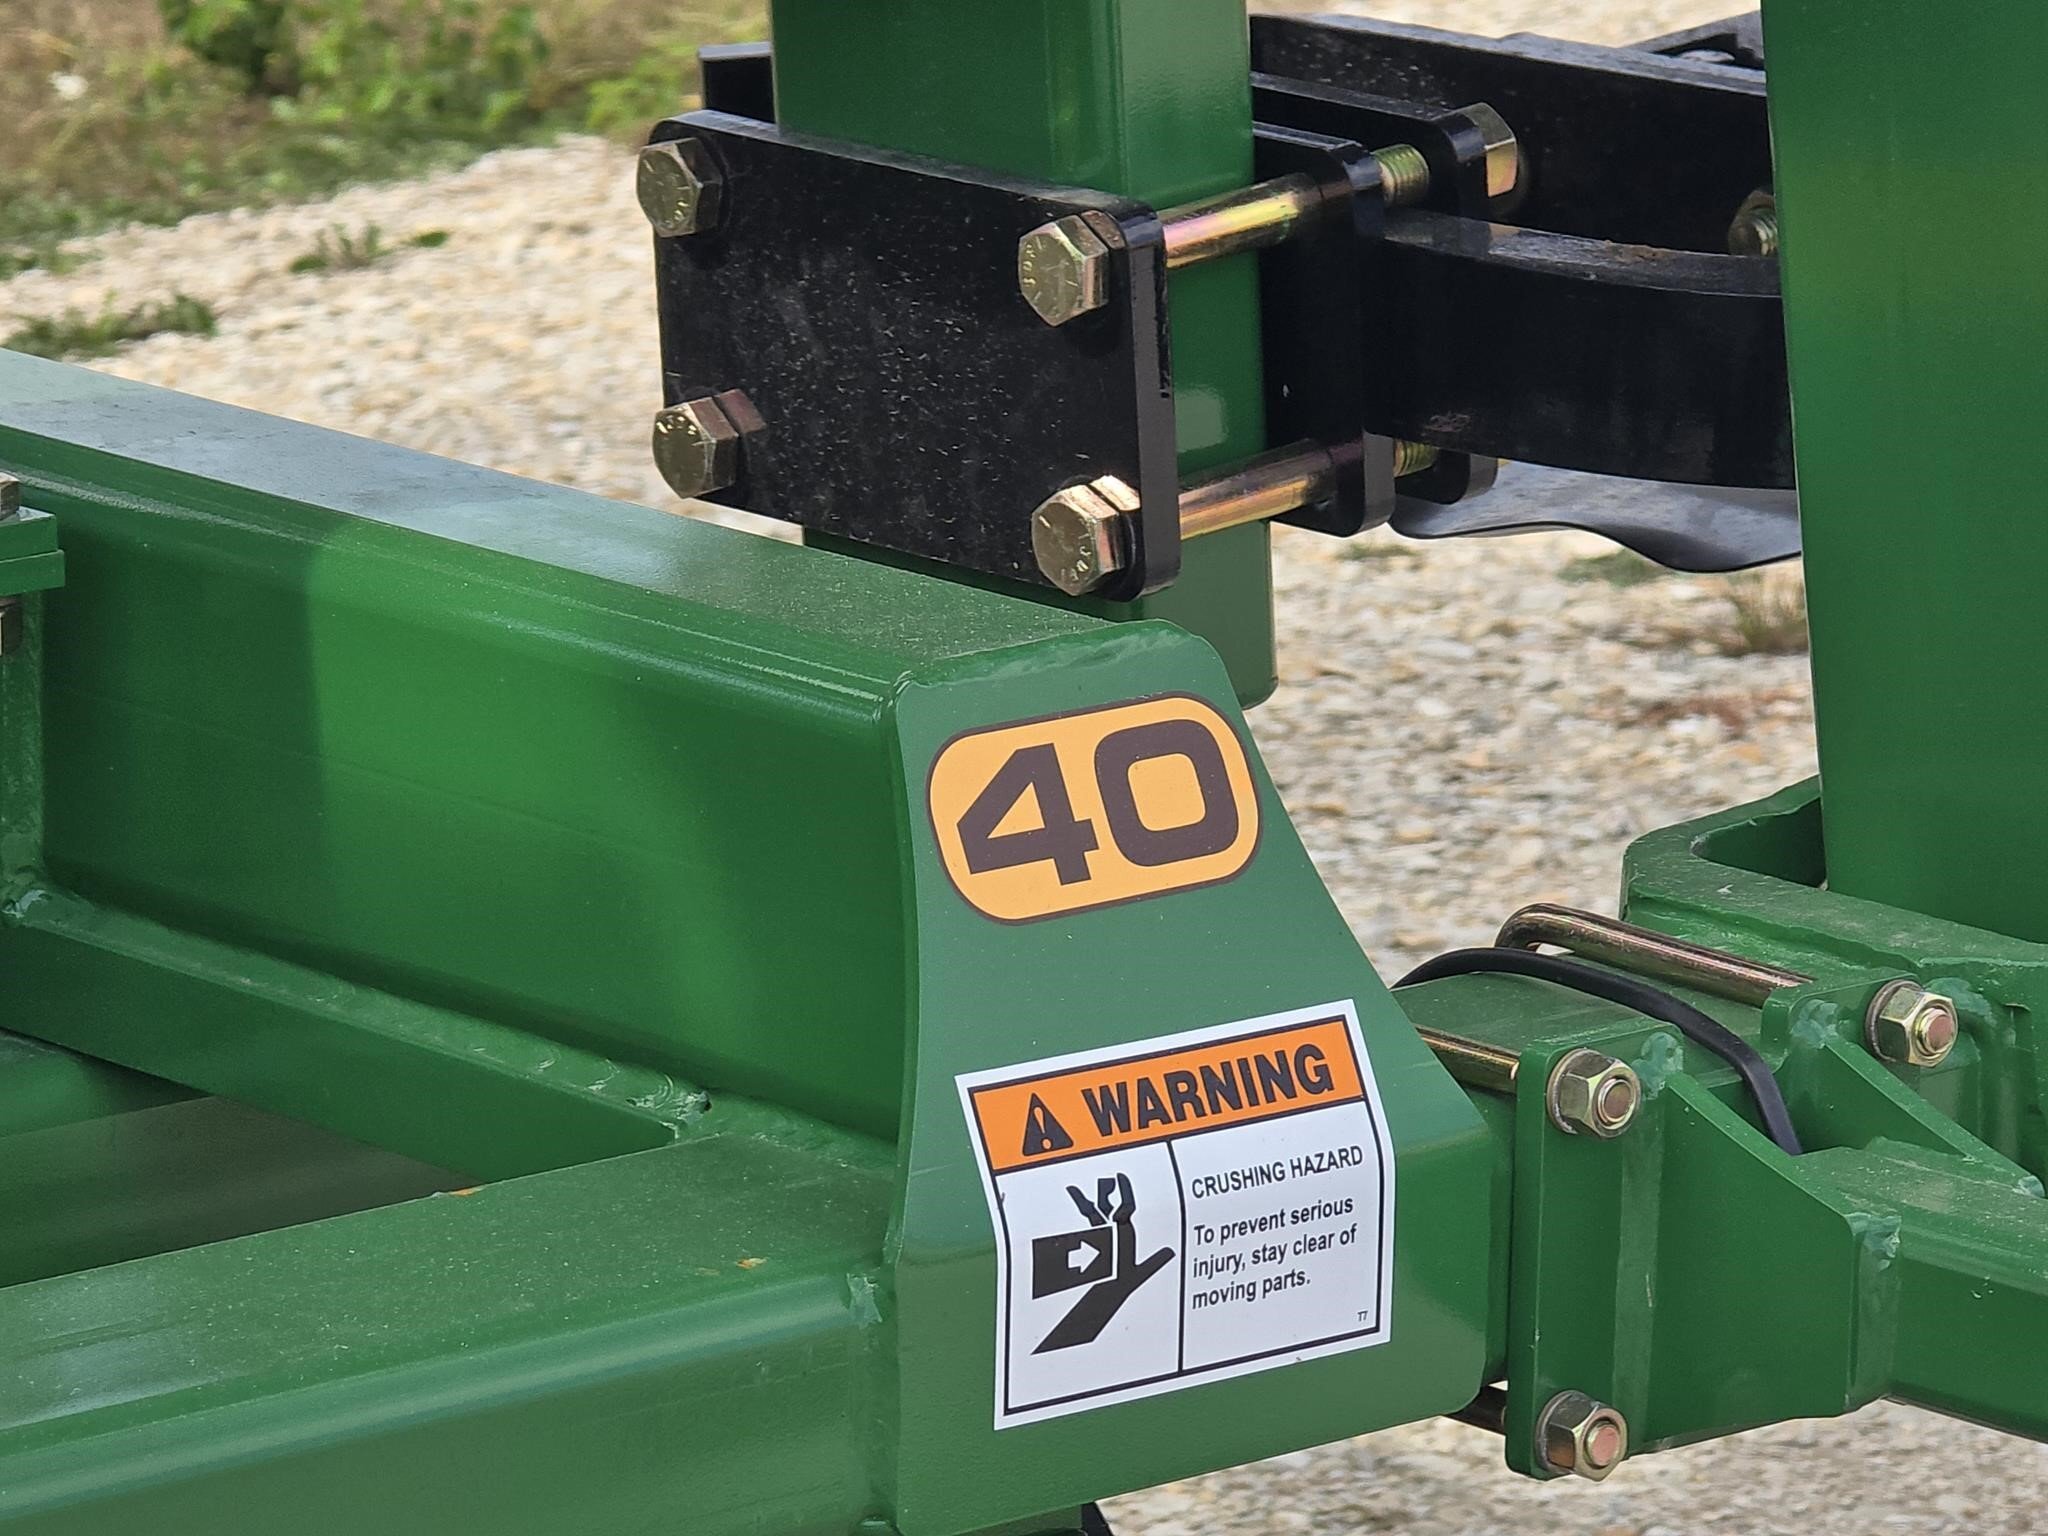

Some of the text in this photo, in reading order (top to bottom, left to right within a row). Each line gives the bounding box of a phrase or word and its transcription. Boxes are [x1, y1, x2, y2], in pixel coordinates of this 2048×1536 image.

[956, 718, 1239, 886] 40
[1081, 1043, 1335, 1138] WARNING
[1191, 1145, 1364, 1199] CRUSHING HAZARD
[1194, 1197, 1354, 1246] To prevent serious
[1192, 1223, 1358, 1280] injury, stay clear of
[1191, 1270, 1312, 1310] moving parts.
